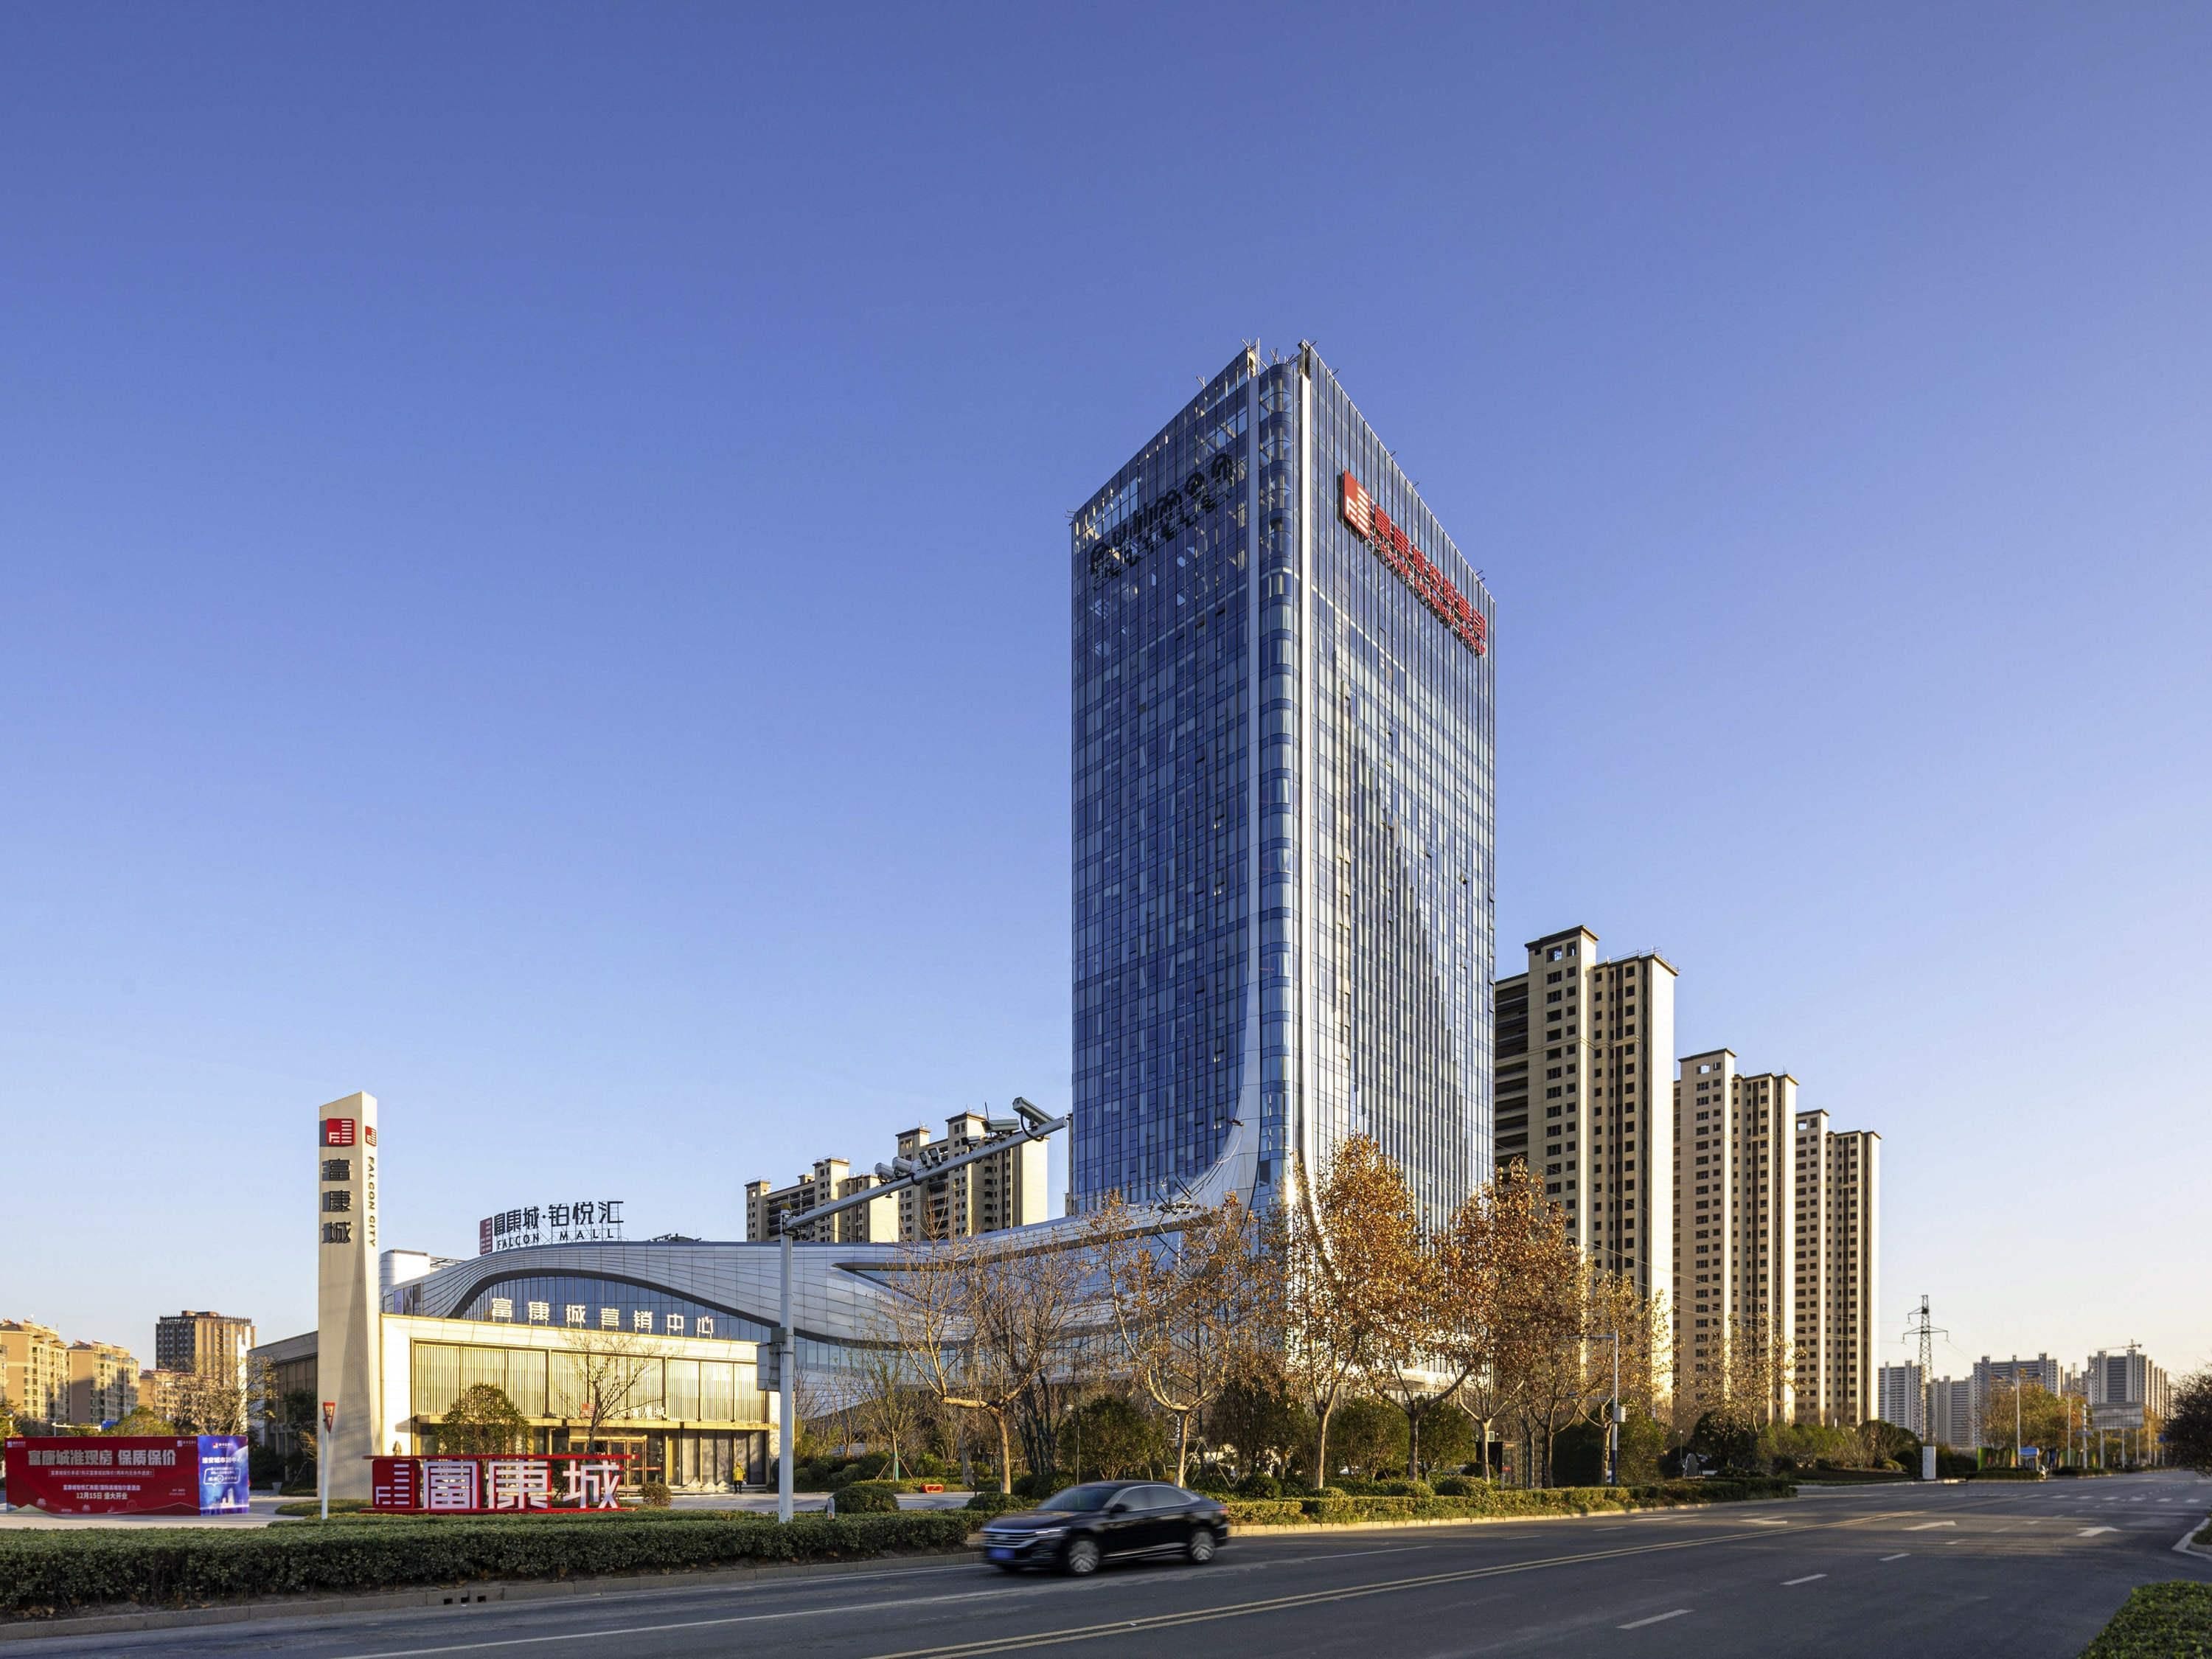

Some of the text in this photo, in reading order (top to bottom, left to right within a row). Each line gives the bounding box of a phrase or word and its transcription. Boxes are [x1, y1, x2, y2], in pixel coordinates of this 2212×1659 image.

[1374, 505, 1486, 641] 富康城控股集团
[1374, 535, 1410, 579] FALCON
[1459, 623, 1486, 655] GROUP
[328, 1158, 351, 1244] 富康城
[367, 1155, 376, 1247] FALCON CITY
[497, 1228, 614, 1250] FALCON MALL
[491, 1298, 714, 1334] 富康城营销中心
[28, 1449, 176, 1466] 富康城准现房 保质保价
[76, 1492, 102, 1500] 12月15日
[423, 1459, 620, 1509] 富康城
